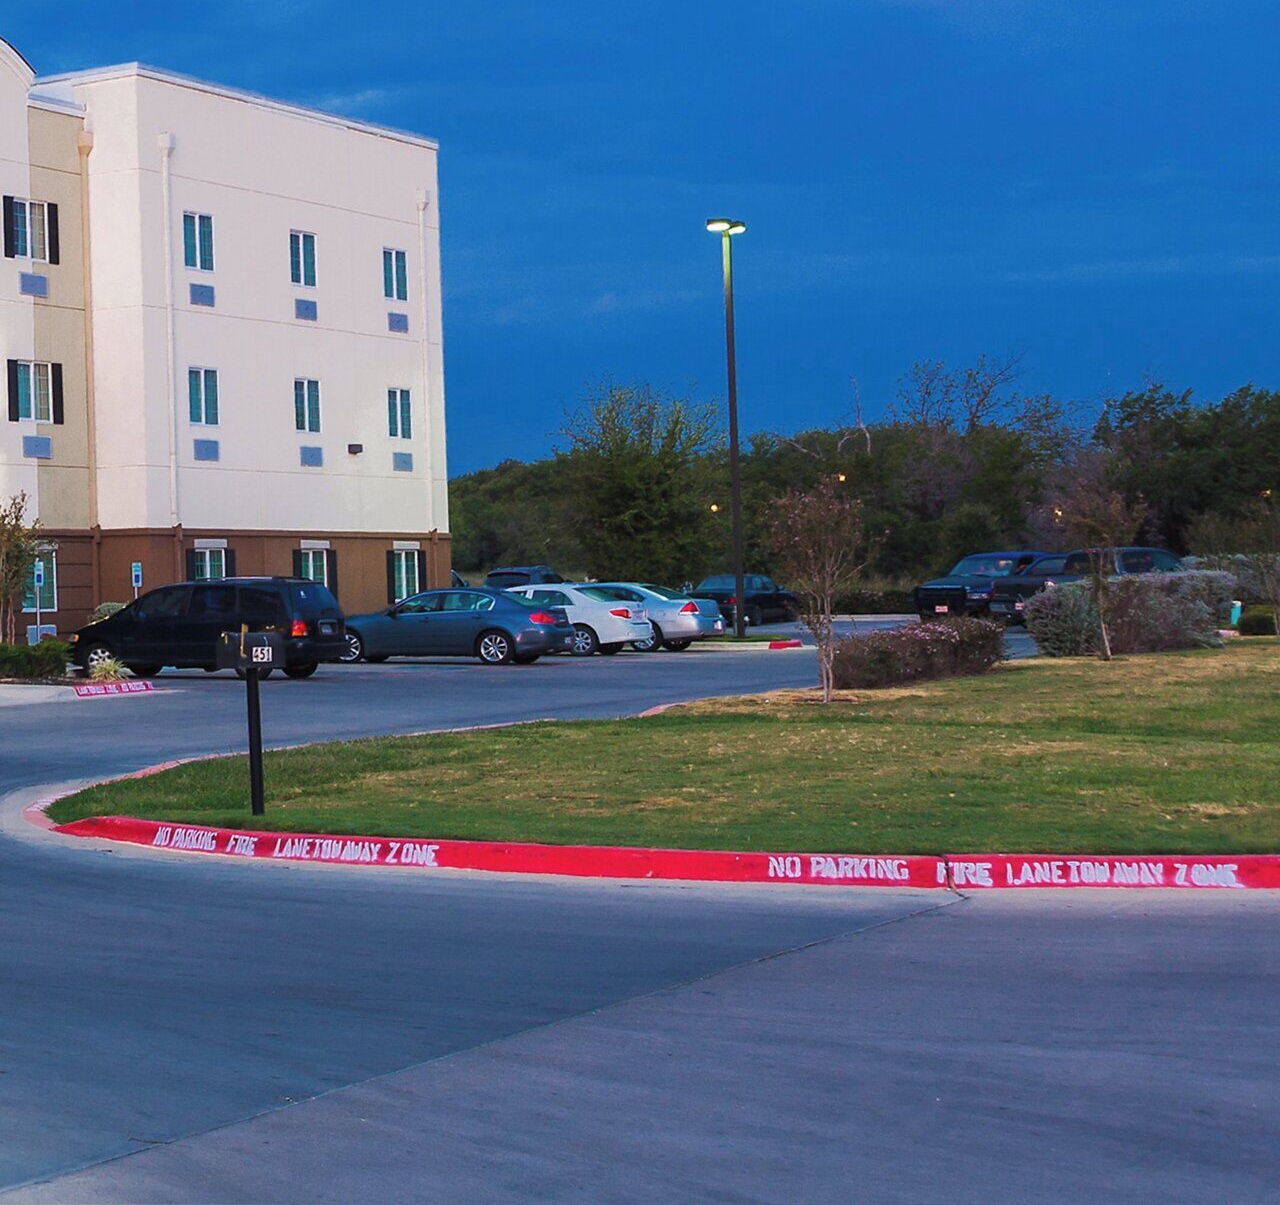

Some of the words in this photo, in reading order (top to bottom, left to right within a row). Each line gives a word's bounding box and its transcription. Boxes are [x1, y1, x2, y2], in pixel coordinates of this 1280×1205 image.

[253, 648, 271, 662] 451
[153, 826, 172, 846] NO
[170, 827, 218, 851] PARKING
[226, 834, 258, 856] FIRE
[385, 842, 440, 867] ZONE
[767, 856, 802, 878] NO
[810, 856, 909, 880] PARKING
[936, 861, 993, 886] FIRE
[1173, 862, 1246, 889] ZONE
